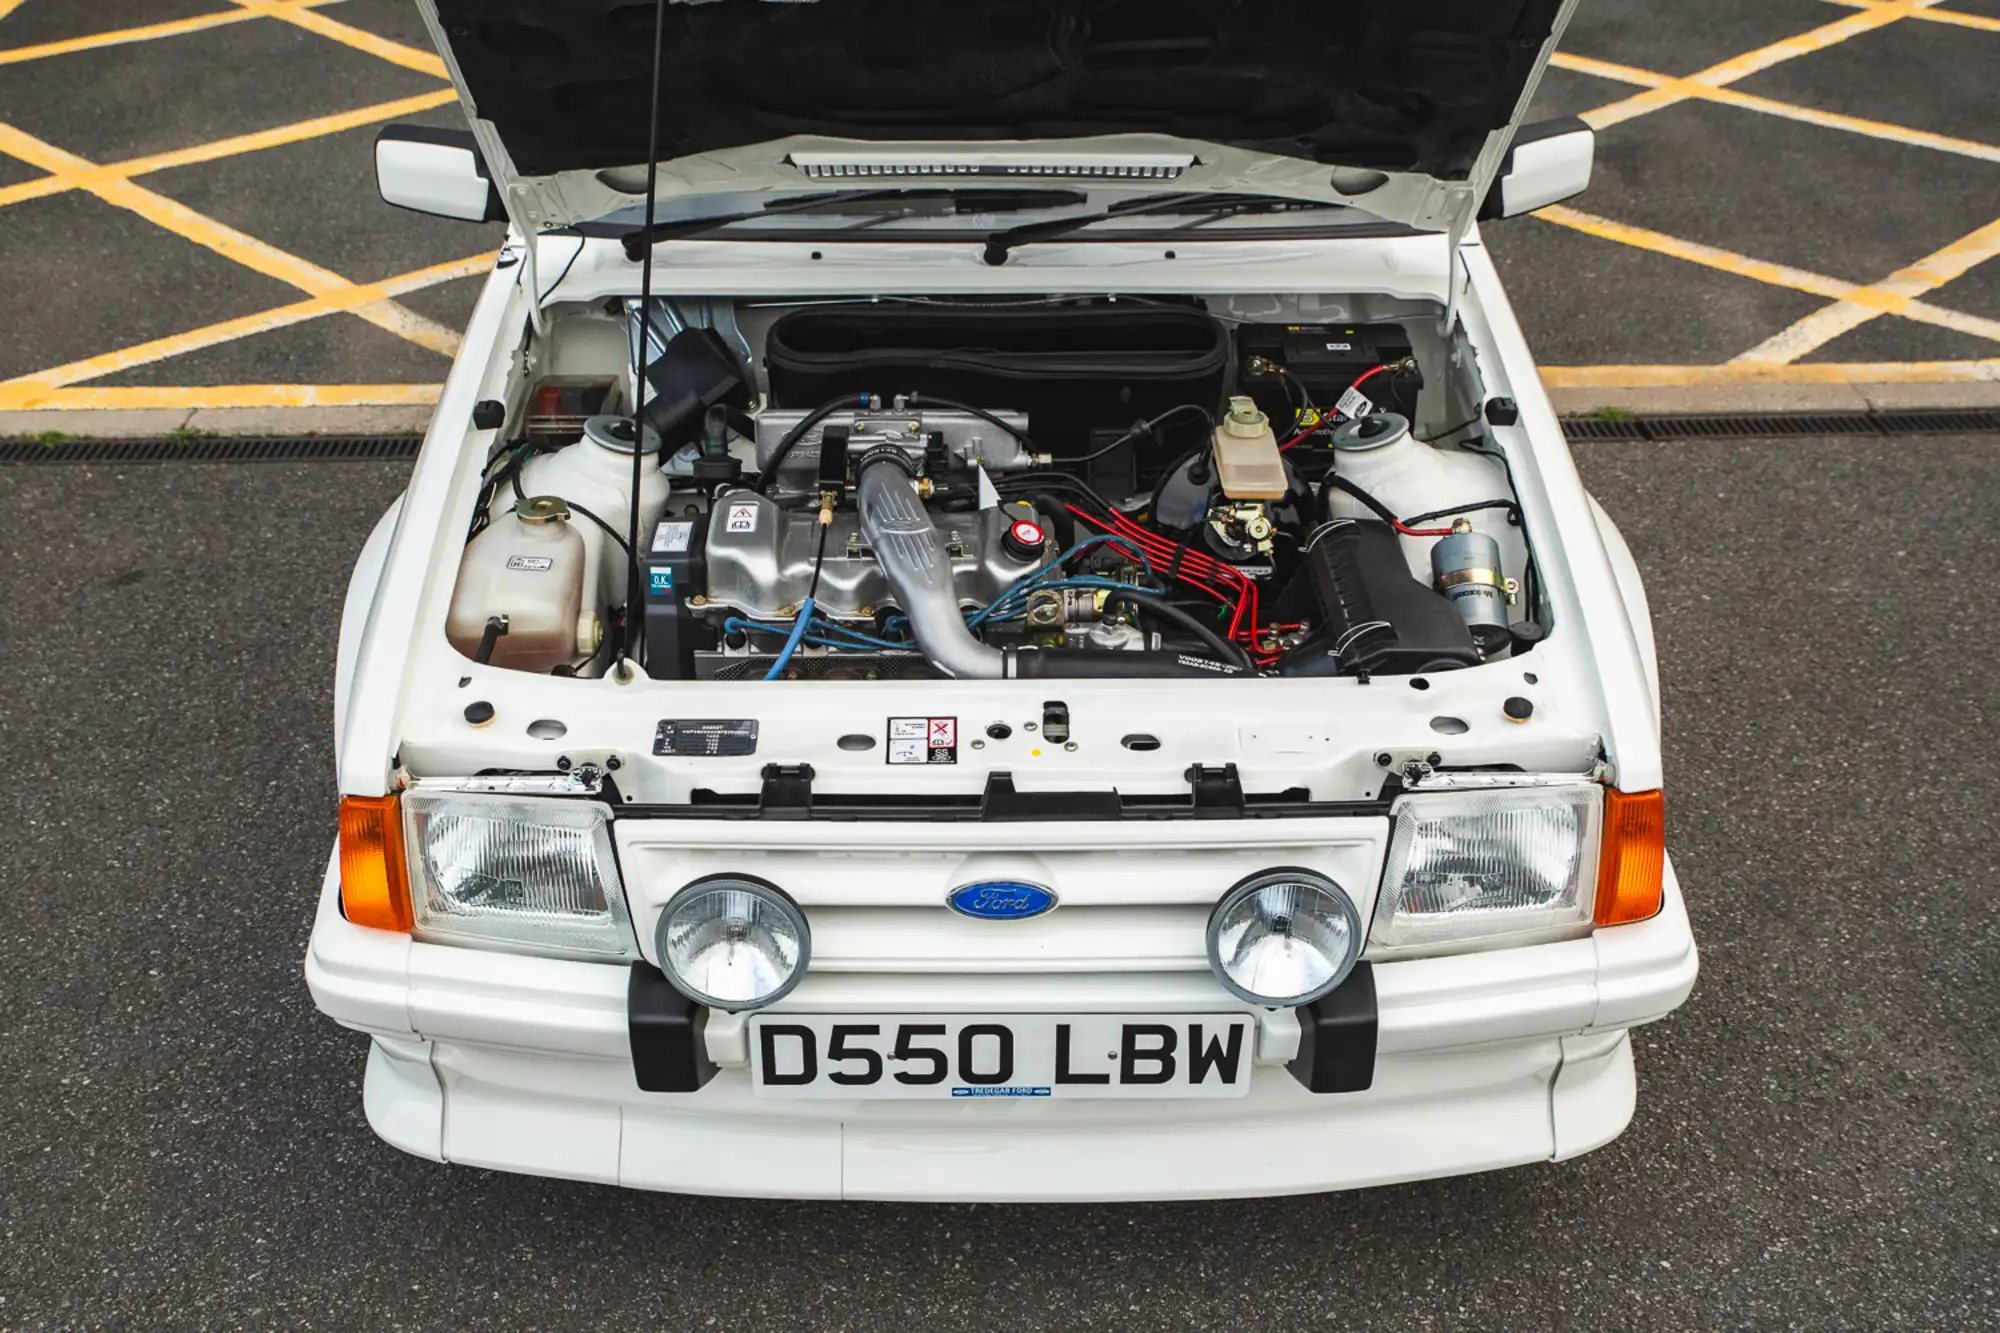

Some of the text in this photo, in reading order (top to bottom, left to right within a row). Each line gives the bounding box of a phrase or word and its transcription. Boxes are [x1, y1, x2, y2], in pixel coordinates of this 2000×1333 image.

[973, 888, 1031, 910] Ford
[760, 1024, 1244, 1085] D550 LBW
[971, 1087, 1033, 1095] TREDEGAR FORD
